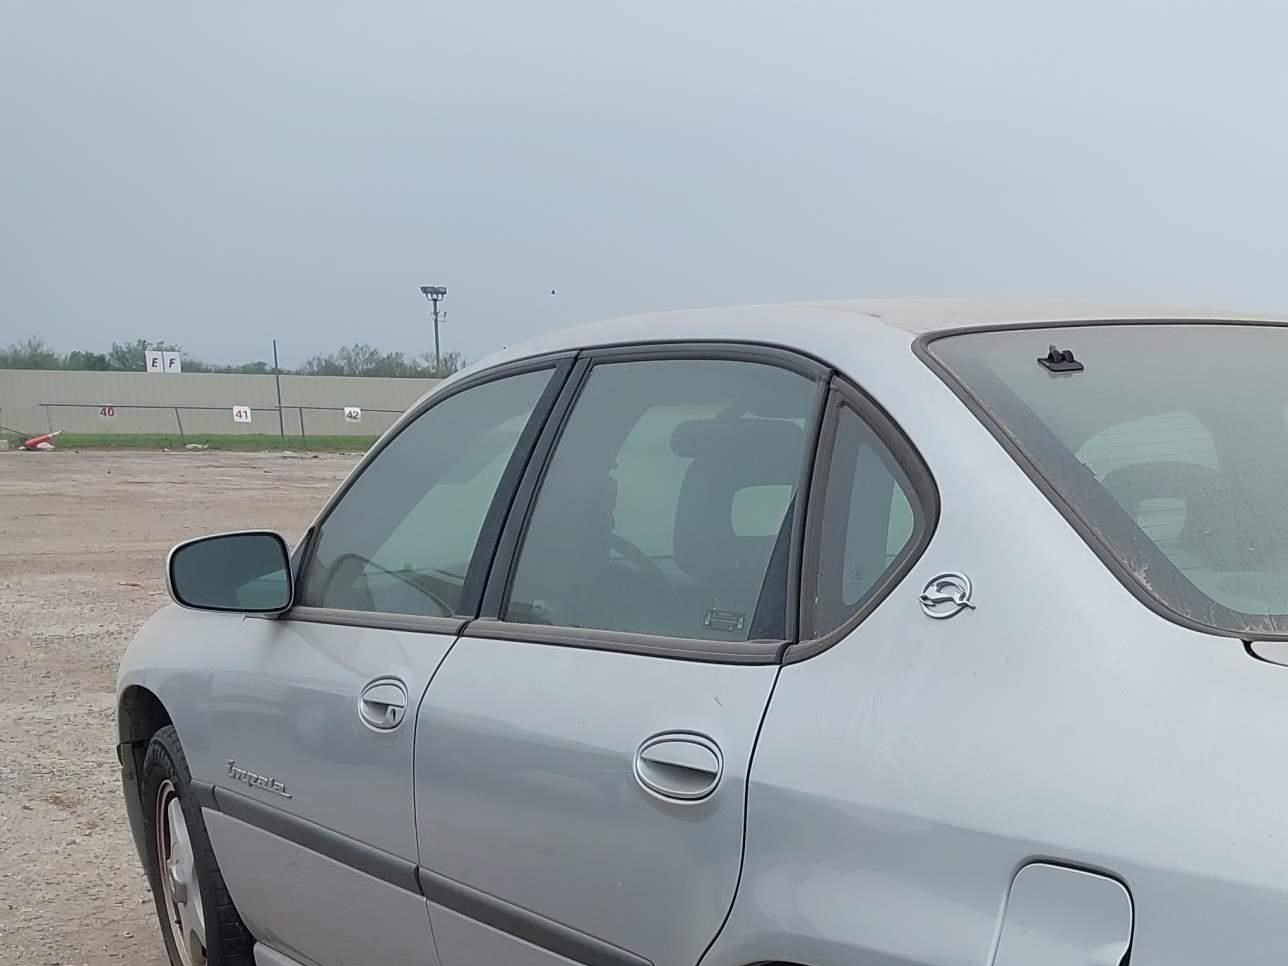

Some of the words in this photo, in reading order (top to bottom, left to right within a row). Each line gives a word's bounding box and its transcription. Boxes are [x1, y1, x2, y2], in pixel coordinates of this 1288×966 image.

[151, 357, 159, 368] E
[168, 358, 176, 369] F
[100, 406, 115, 417] 40
[235, 410, 248, 420] 41
[346, 410, 360, 420] 42
[226, 759, 293, 799] Impala
